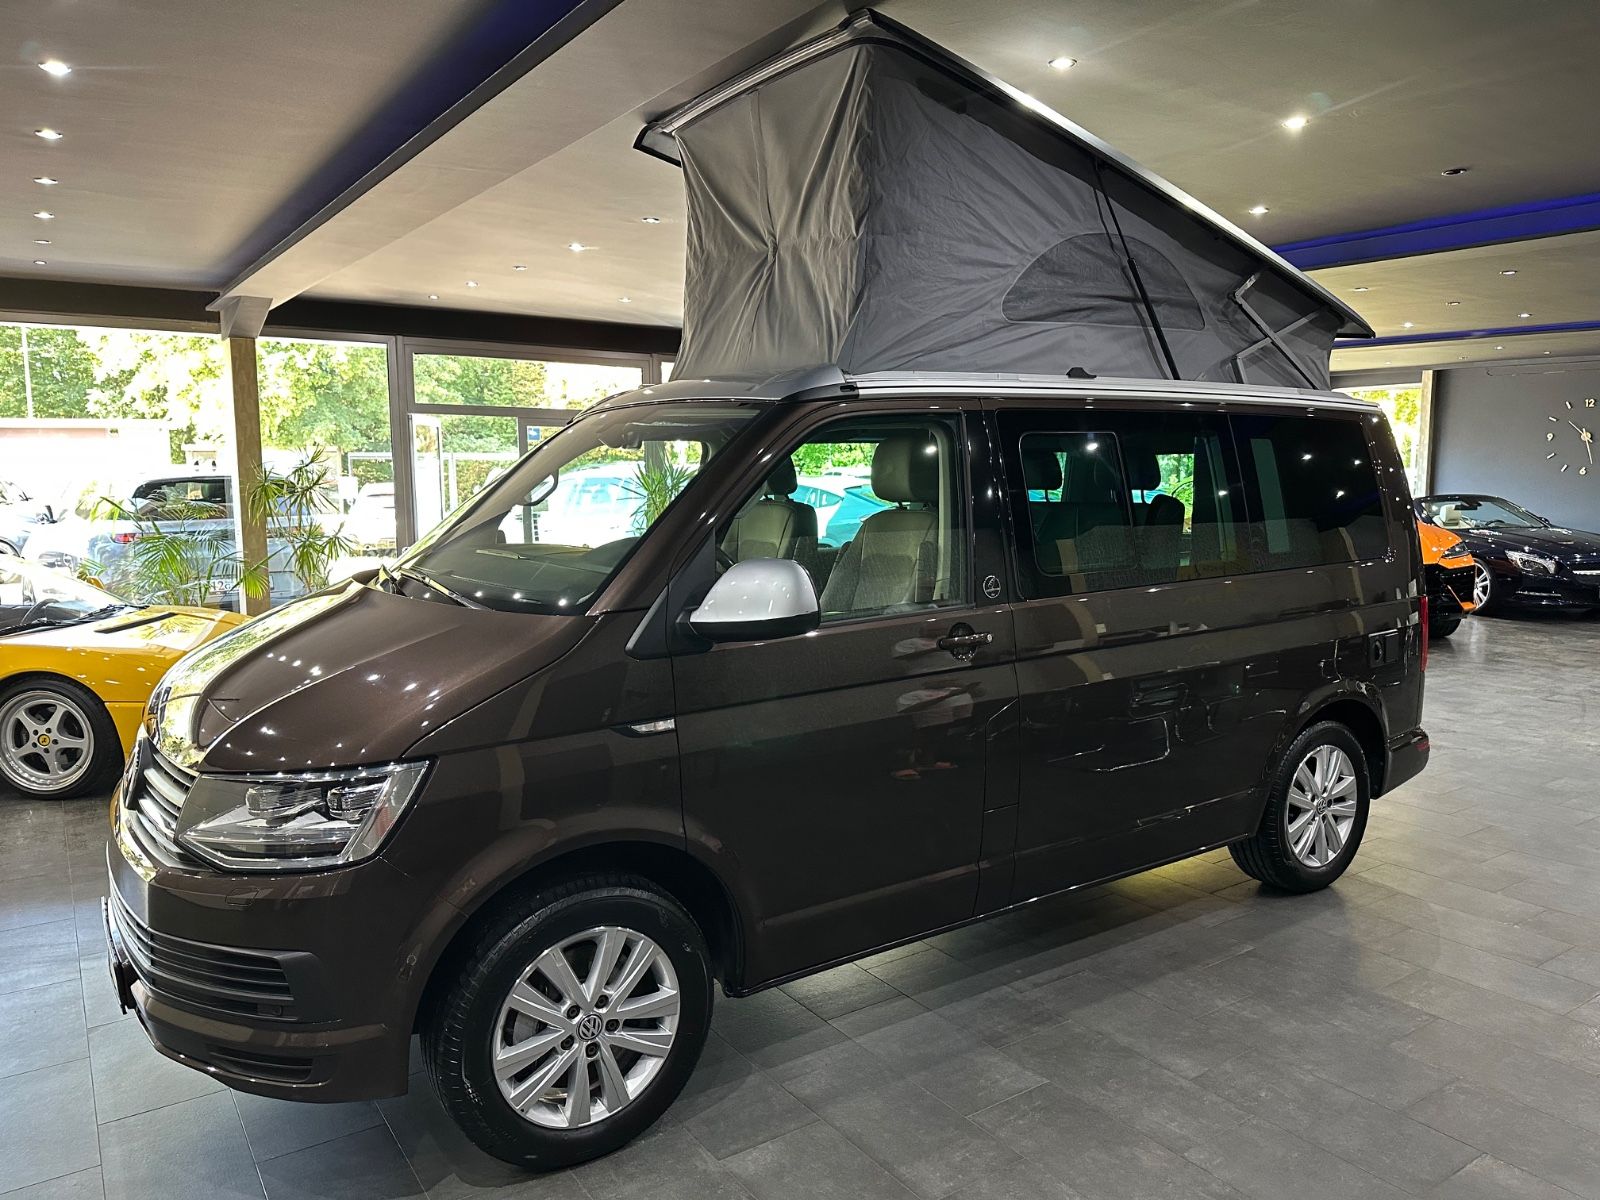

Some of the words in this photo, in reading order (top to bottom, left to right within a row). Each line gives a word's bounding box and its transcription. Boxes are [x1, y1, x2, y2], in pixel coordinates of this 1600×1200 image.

[1585, 399, 1595, 407] 12
[1547, 433, 1554, 441] 9
[1579, 467, 1587, 475] 6
[579, 1015, 602, 1039] VW
